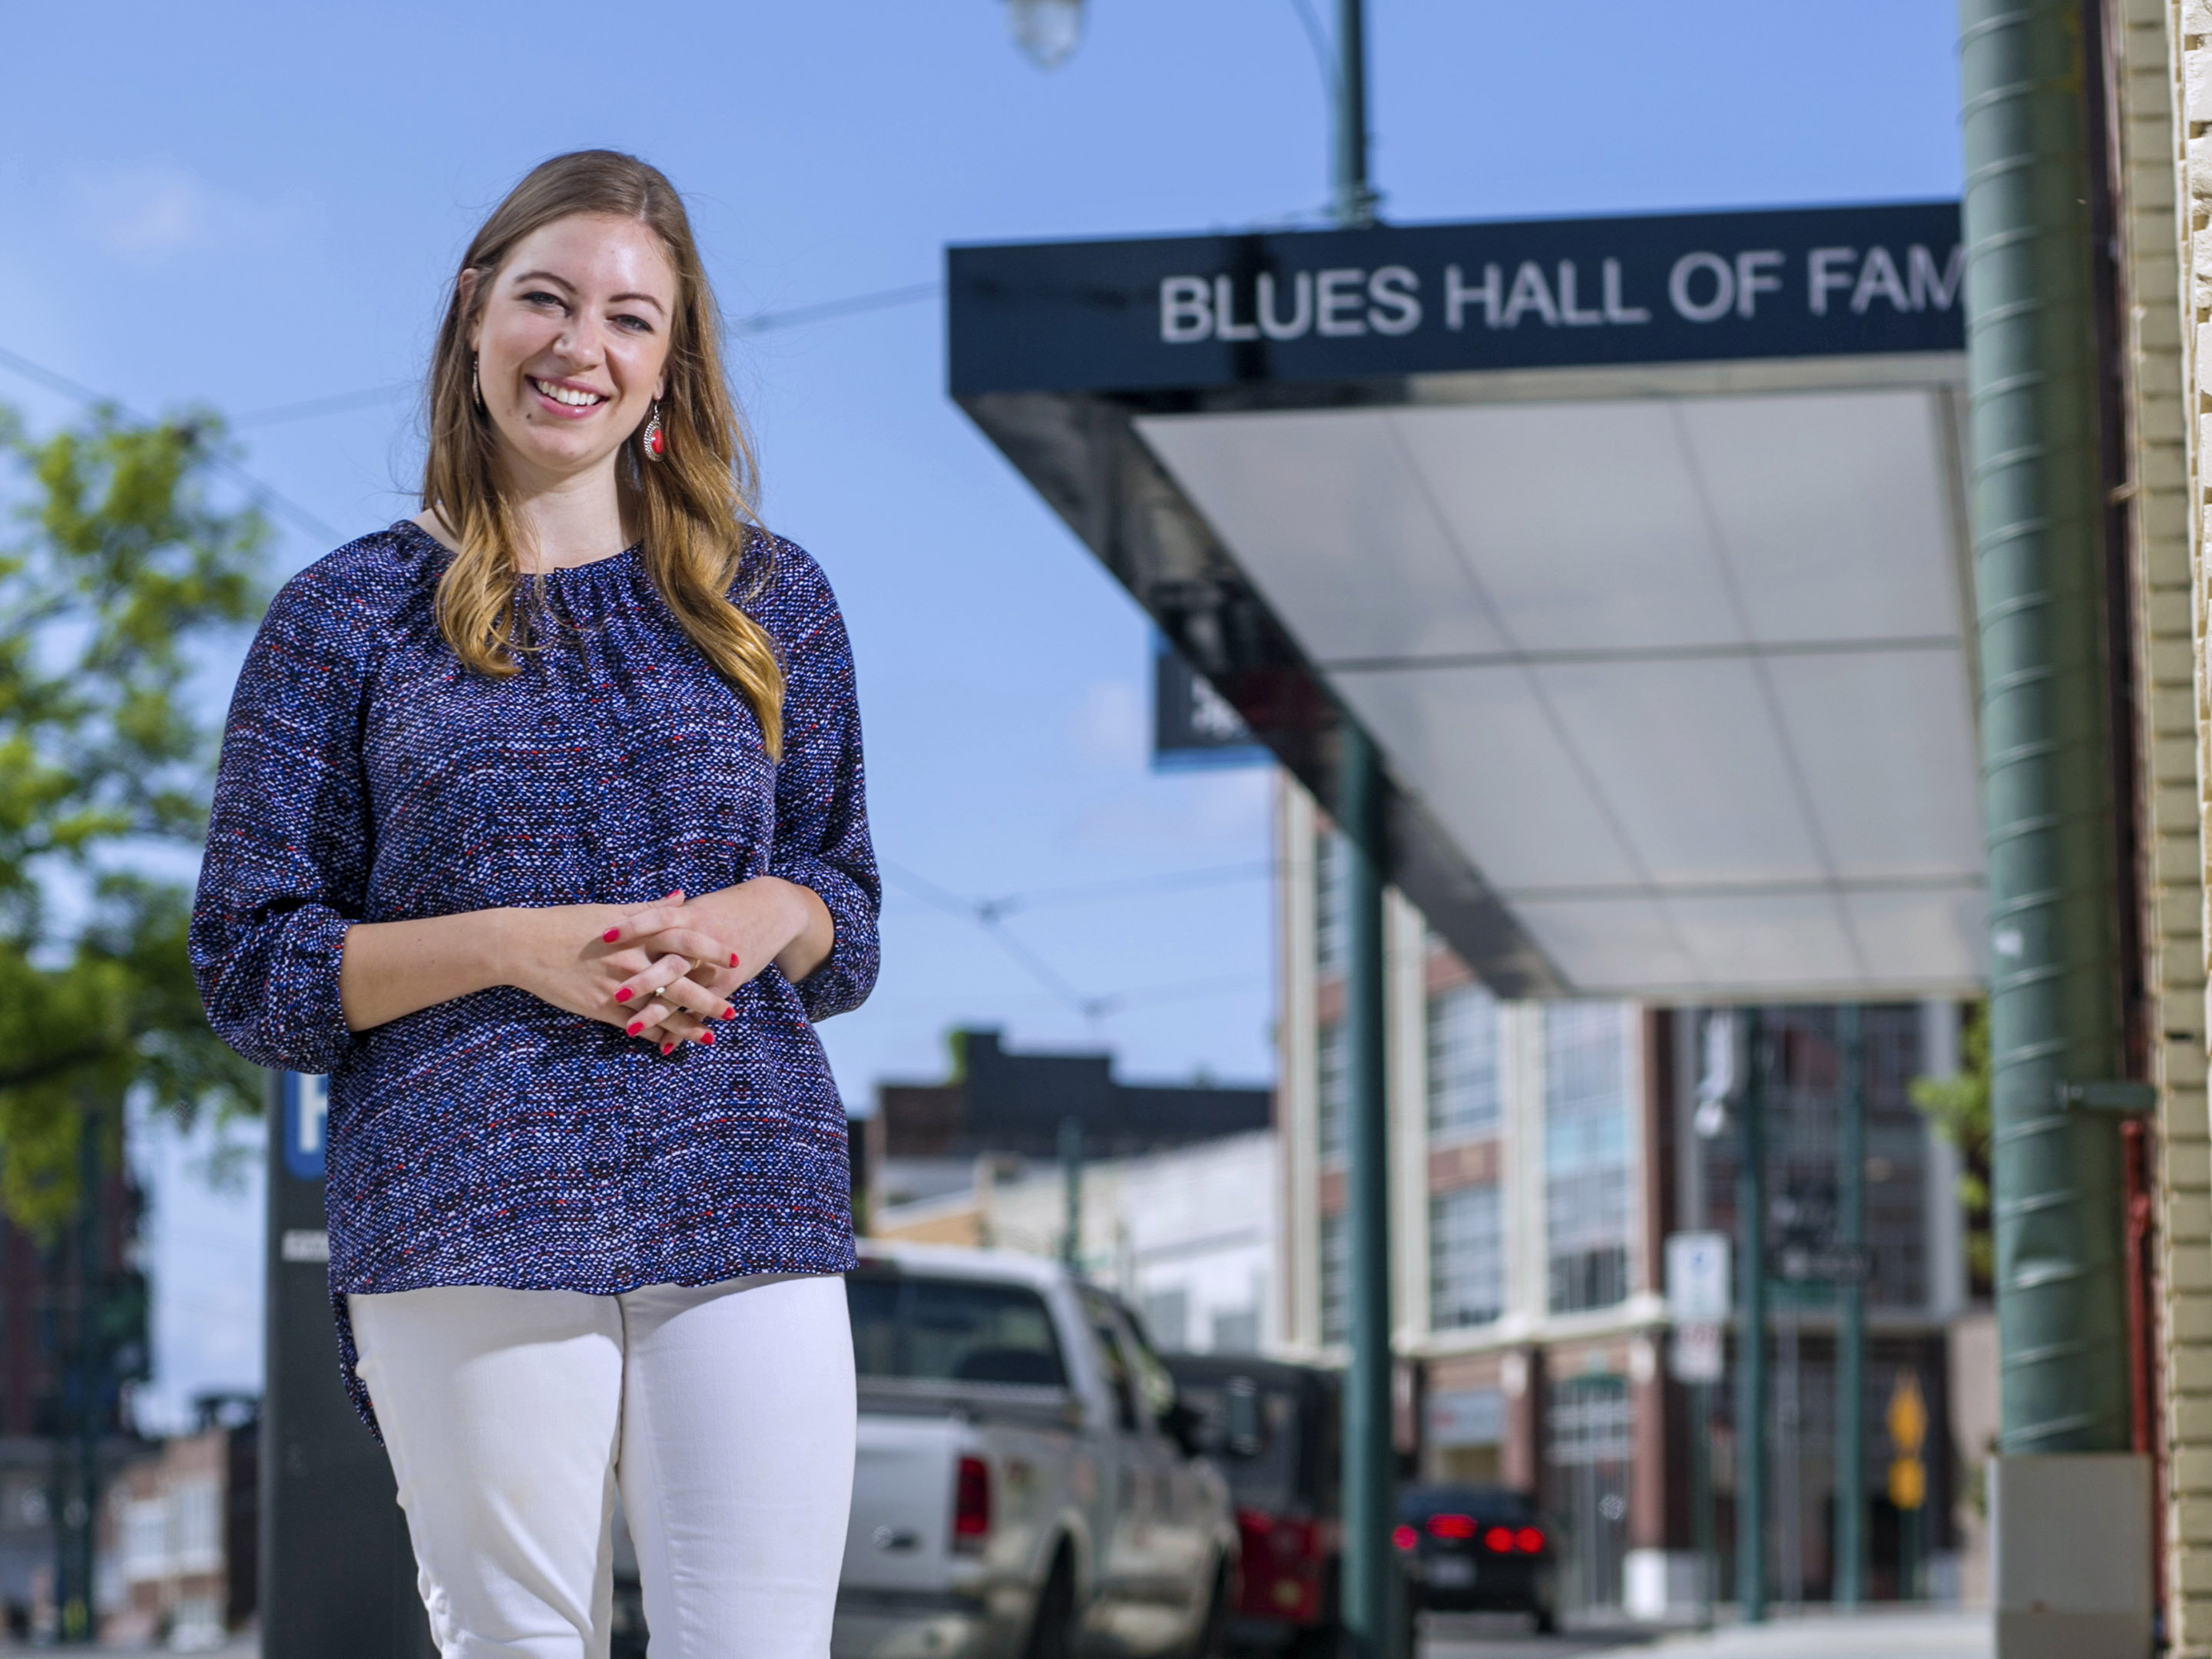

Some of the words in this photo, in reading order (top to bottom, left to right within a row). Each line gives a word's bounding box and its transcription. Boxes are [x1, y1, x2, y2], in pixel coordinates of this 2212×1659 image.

[1161, 266, 1422, 343] BLUES
[1445, 257, 1651, 331] HALL
[1668, 250, 1786, 323] OF
